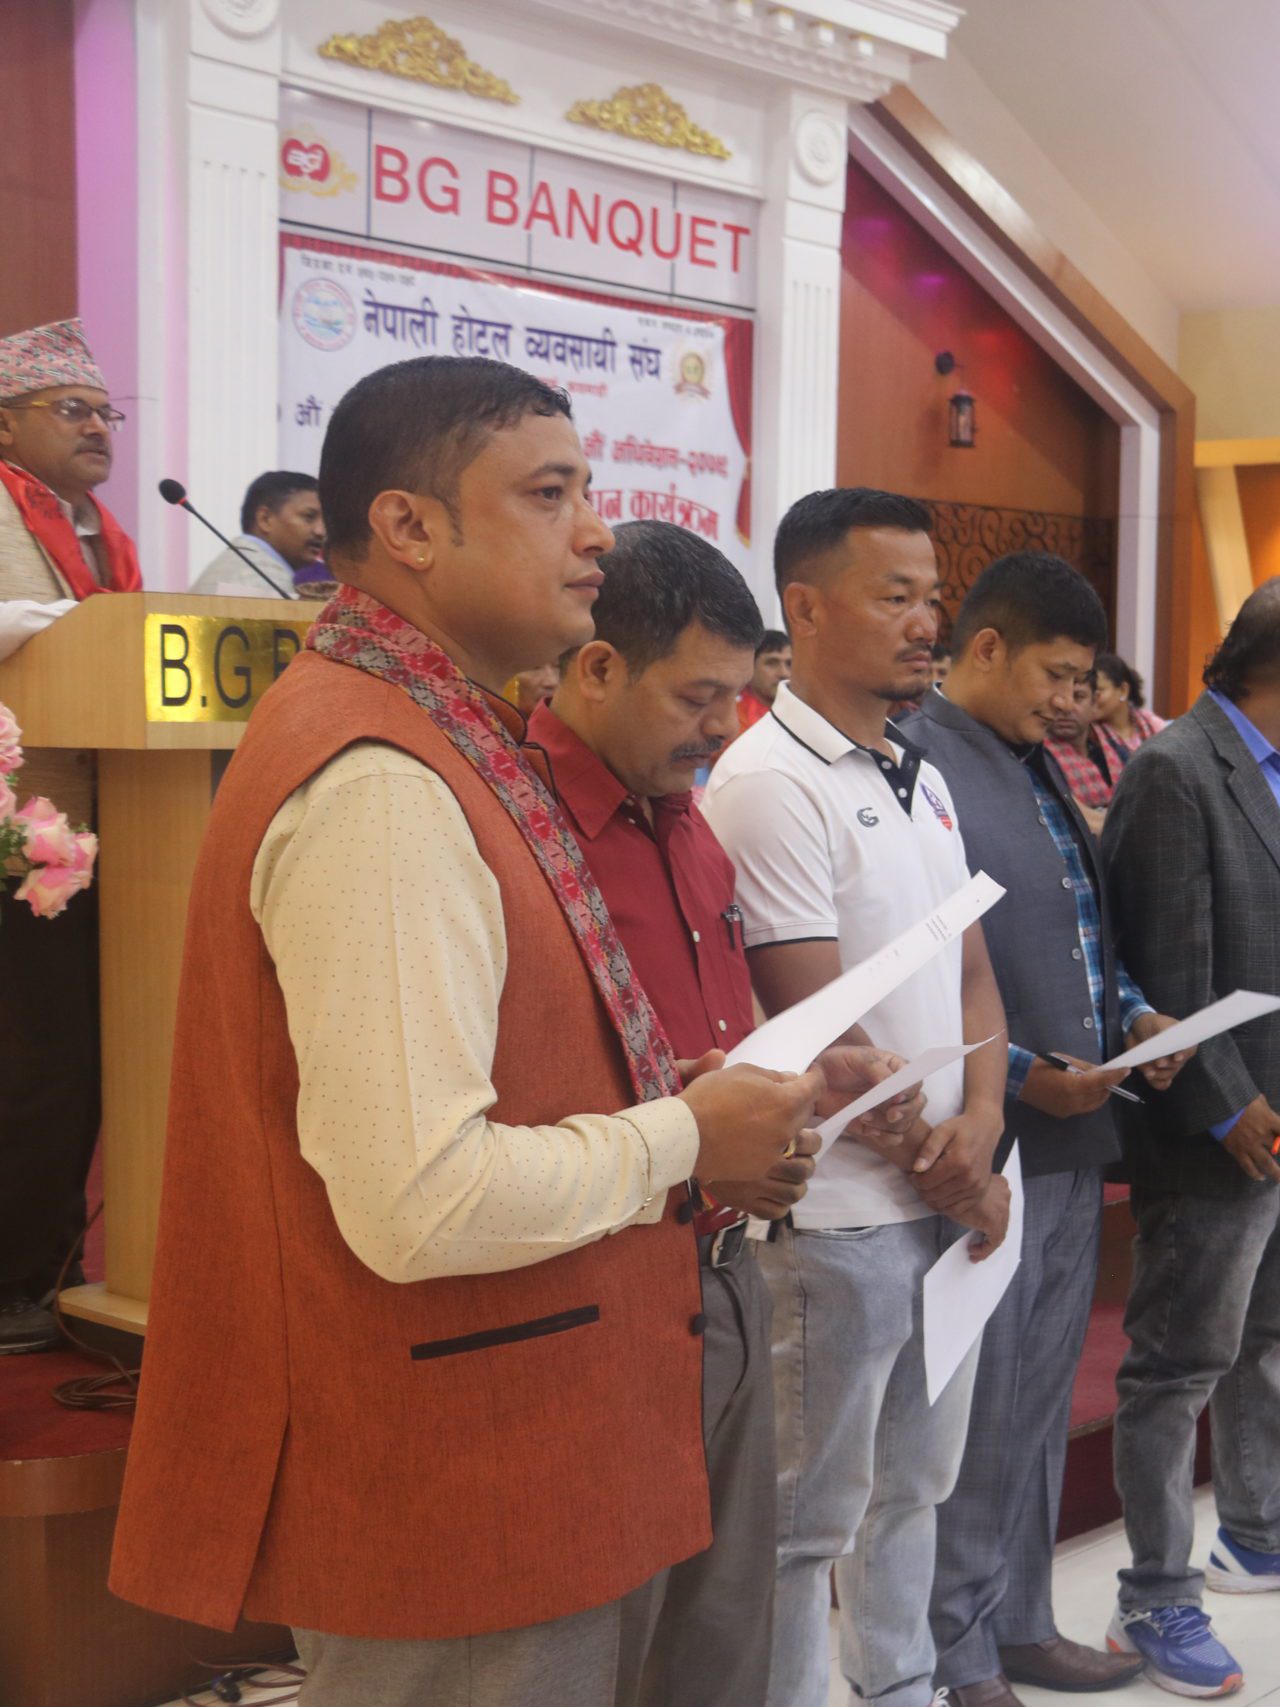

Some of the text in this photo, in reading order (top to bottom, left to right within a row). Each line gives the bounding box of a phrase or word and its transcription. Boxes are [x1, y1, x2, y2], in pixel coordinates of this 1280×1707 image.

[374, 144, 752, 274] BG BANQUET
[362, 288, 439, 348] नेपाली
[450, 304, 513, 358] होटल
[525, 327, 617, 373] व्यवसायी
[628, 338, 662, 381] संघ
